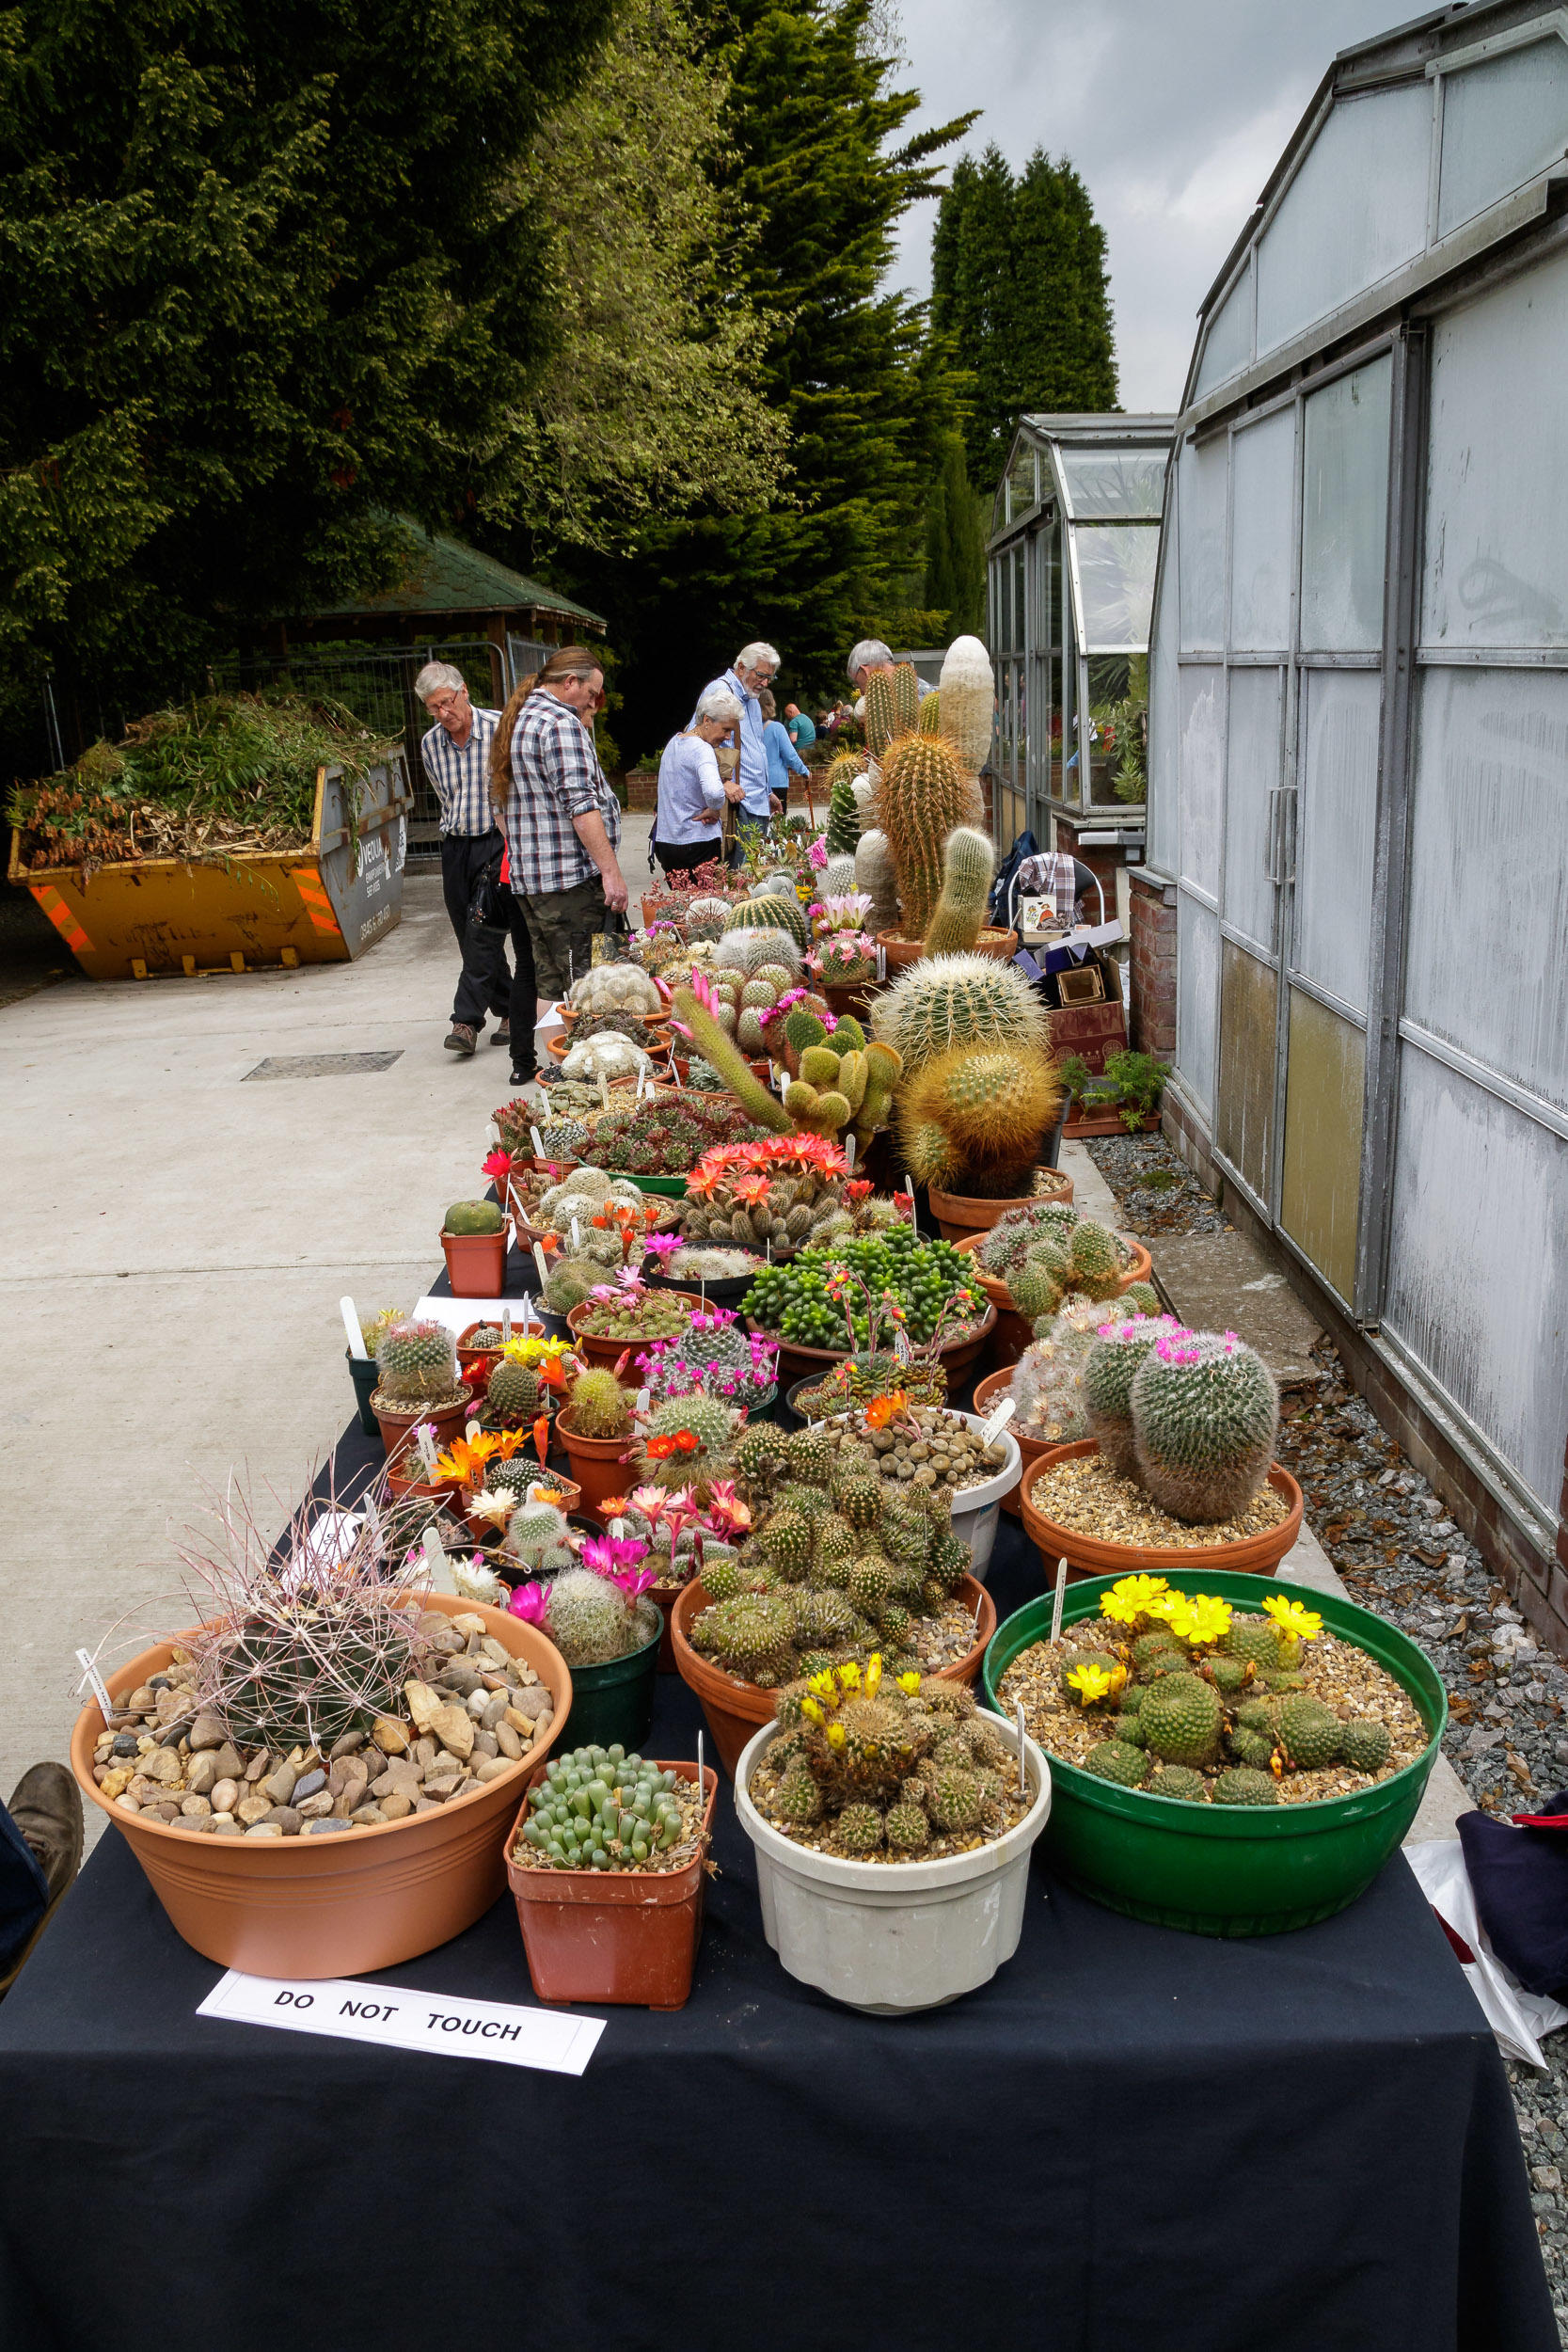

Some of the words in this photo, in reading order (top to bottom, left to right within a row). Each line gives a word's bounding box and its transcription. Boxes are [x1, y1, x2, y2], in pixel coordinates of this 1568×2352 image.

[274, 1991, 315, 2009] DO
[339, 2000, 400, 2022] NOT
[426, 2013, 523, 2041] TOUCH
